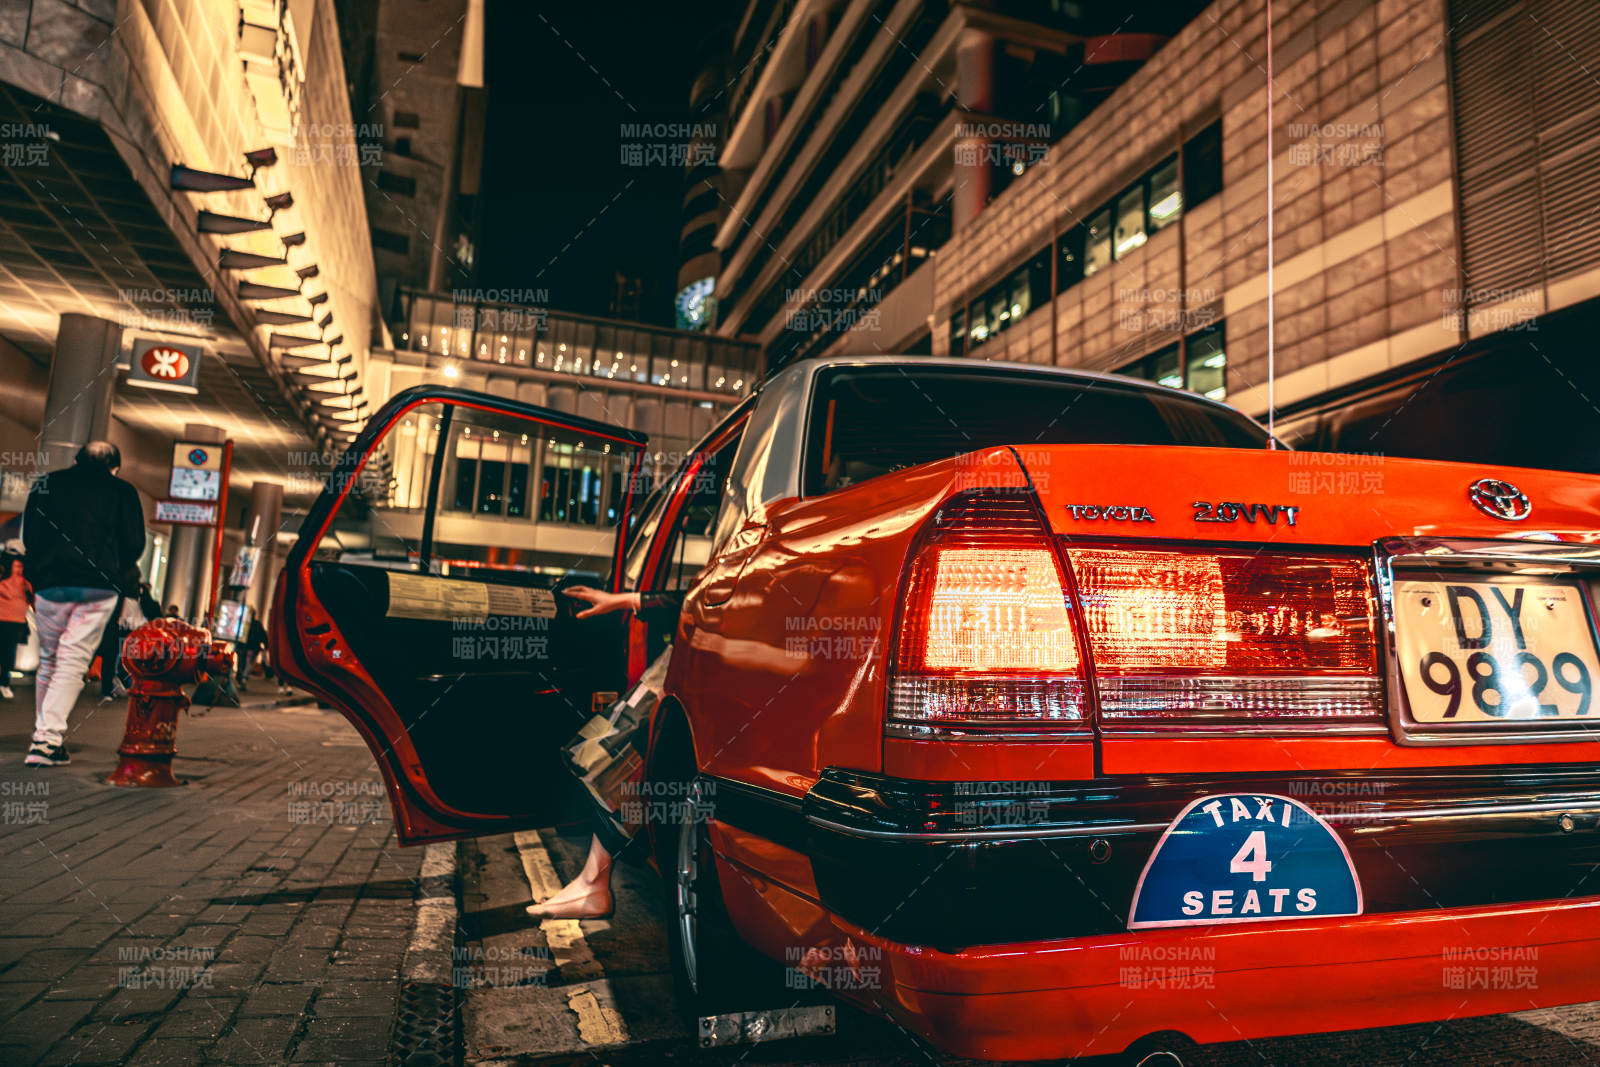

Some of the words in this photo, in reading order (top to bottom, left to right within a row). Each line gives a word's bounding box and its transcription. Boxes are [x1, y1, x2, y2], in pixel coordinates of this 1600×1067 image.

[1066, 504, 1155, 522] TOYOTA
[1446, 586, 1527, 649] DY
[1420, 652, 1592, 718] 9829
[1203, 797, 1292, 828] TAXI
[1230, 831, 1272, 881] 4
[1181, 888, 1317, 916] SEATS
